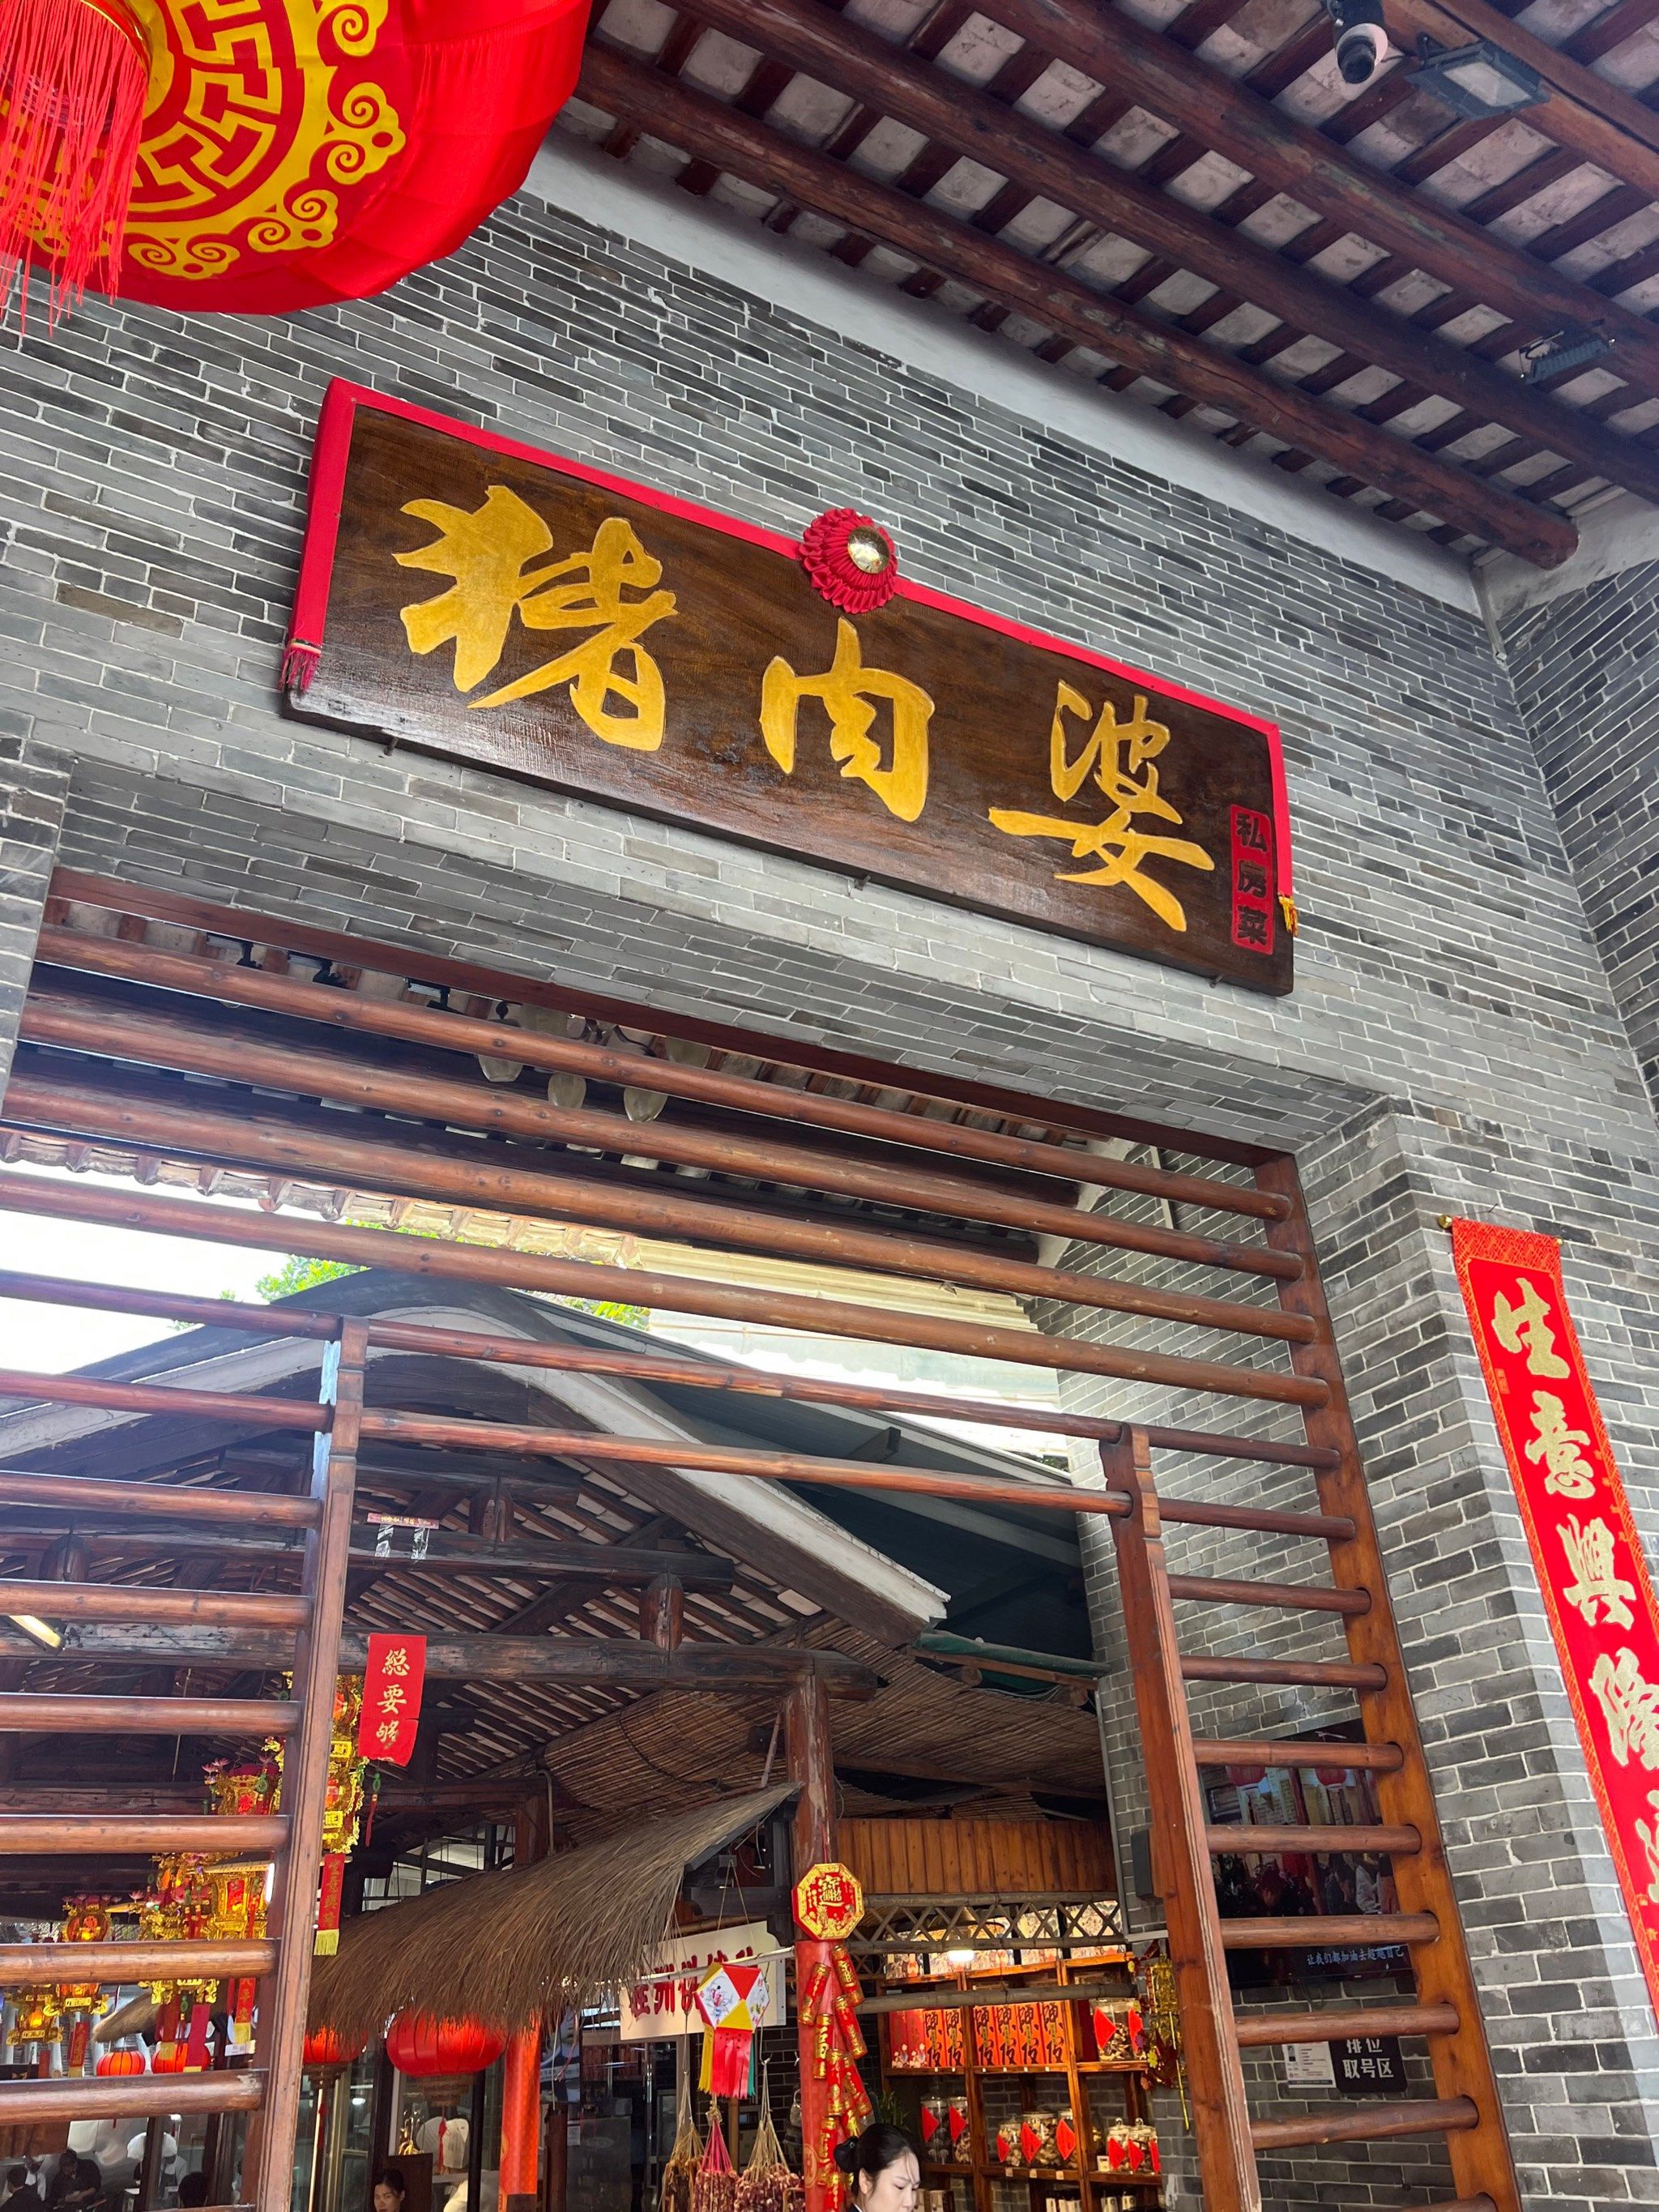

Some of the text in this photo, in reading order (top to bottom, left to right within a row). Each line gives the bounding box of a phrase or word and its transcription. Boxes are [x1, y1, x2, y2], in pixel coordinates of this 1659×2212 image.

[392, 485, 1215, 933] 猪肉婆
[1235, 812, 1269, 946] 私房菜
[1491, 1279, 1659, 1904] 生意興隆
[1306, 1945, 1405, 1966] 让我们都加油去超越自己
[1342, 2058, 1394, 2080] 取号区
[1346, 2038, 1383, 2054] 排位
